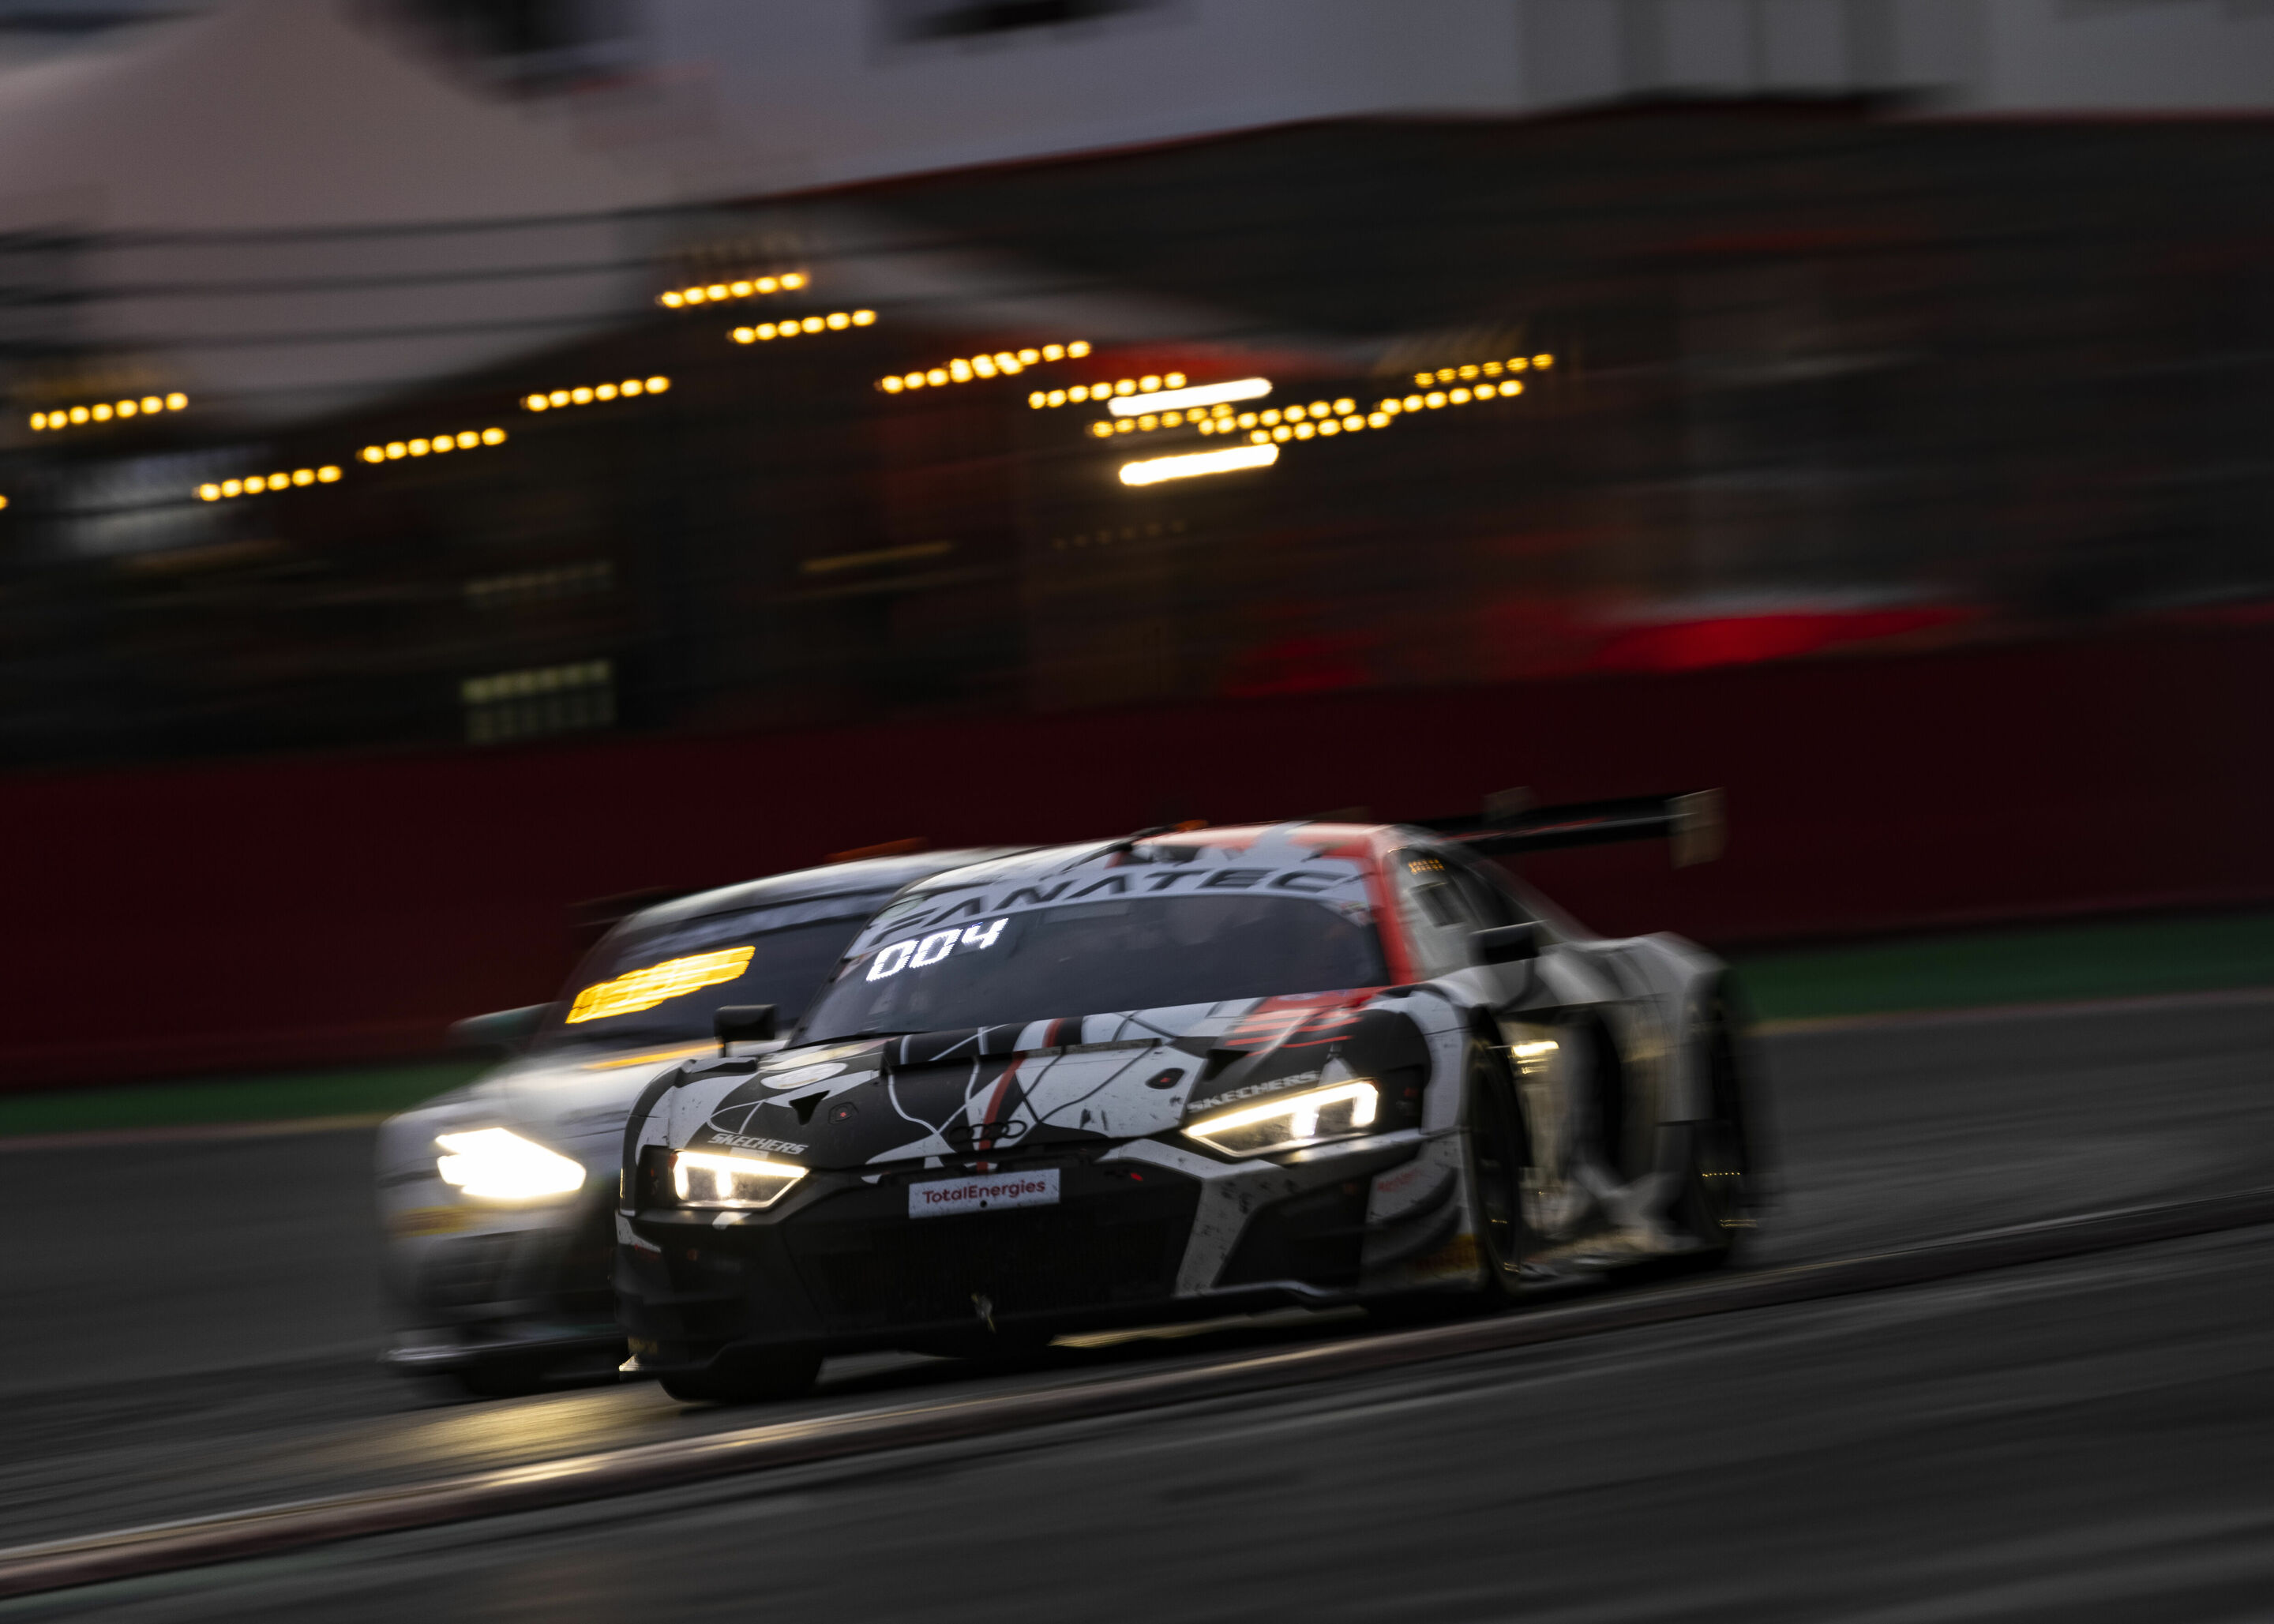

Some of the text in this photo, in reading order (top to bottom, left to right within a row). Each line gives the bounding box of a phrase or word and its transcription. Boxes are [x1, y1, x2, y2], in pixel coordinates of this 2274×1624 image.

[869, 868, 1350, 946] FANATEC
[866, 917, 1009, 981] 004
[1186, 1070, 1322, 1113] SKECHERS
[707, 1132, 809, 1155] SKECHERS
[922, 1180, 1045, 1204] TotalEnergies
